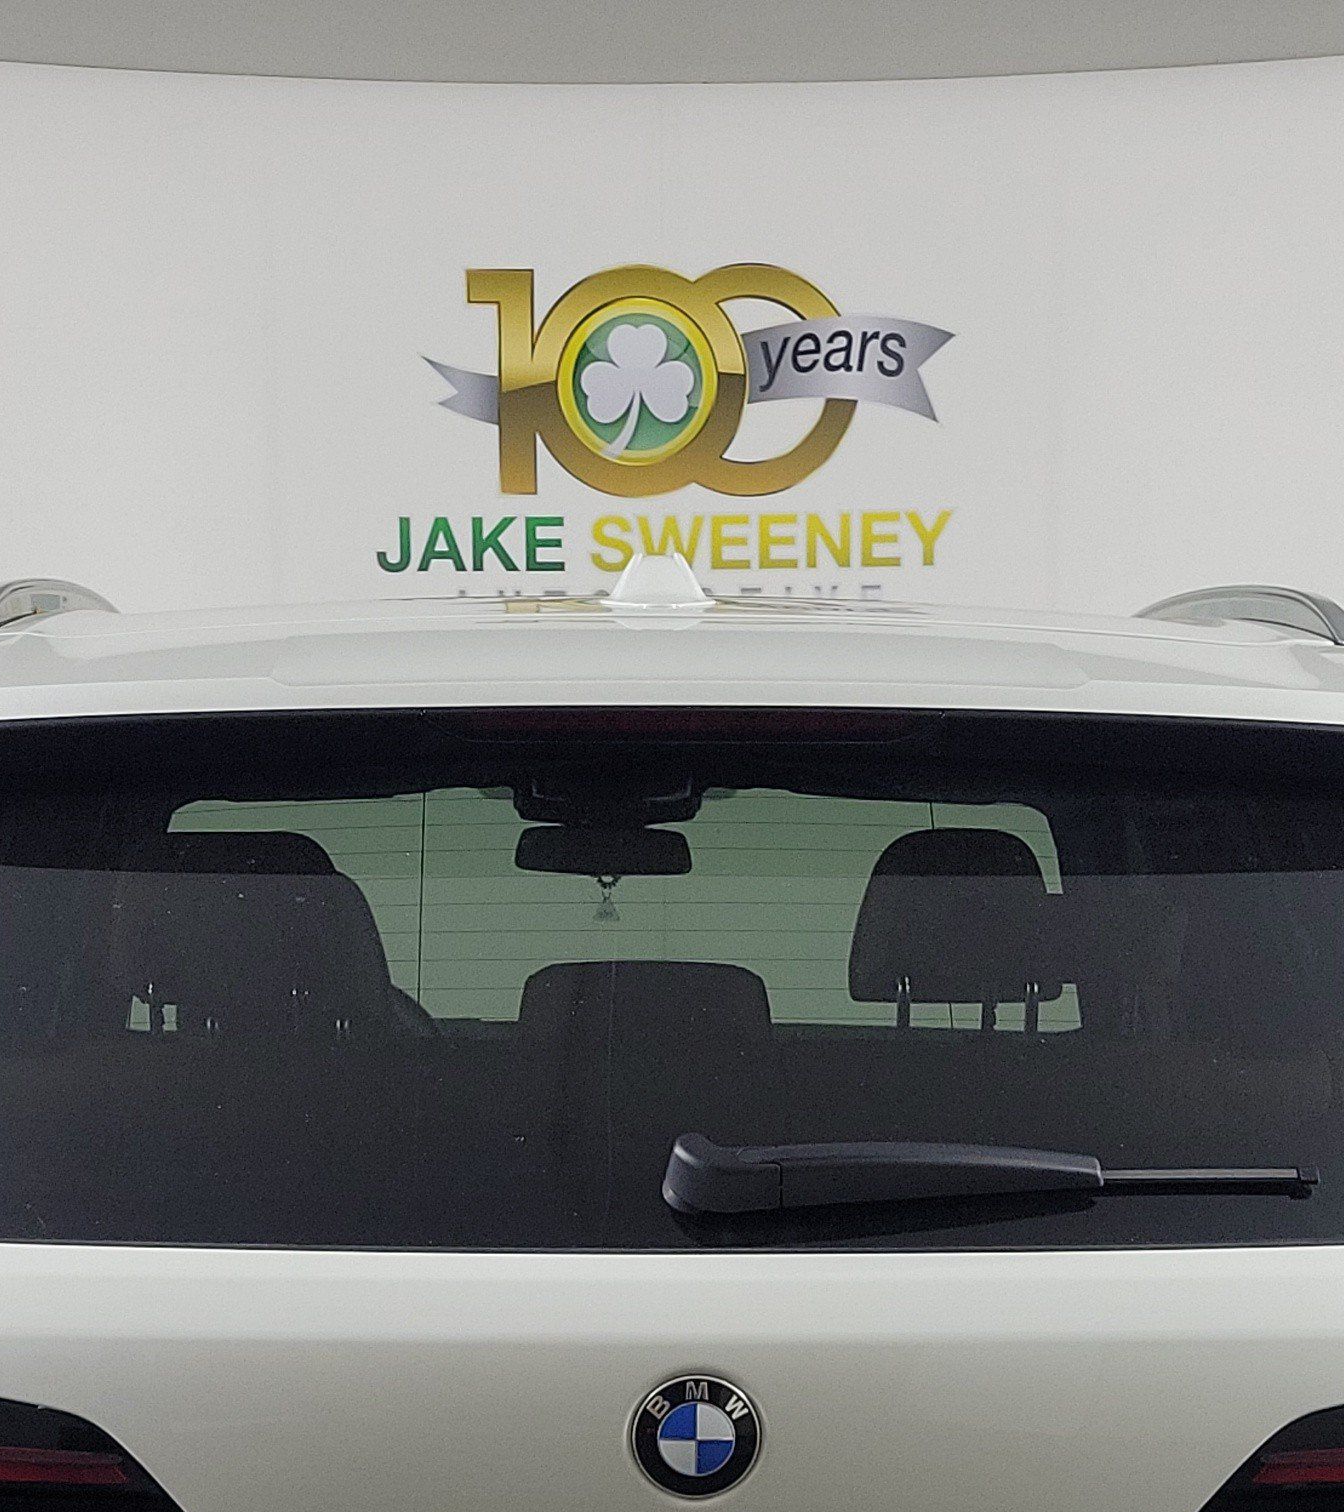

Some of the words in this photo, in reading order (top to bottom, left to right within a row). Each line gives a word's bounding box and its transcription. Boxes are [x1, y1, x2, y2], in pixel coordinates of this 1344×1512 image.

[465, 262, 858, 497] 100
[759, 328, 908, 392] years
[376, 515, 566, 573] JAKE
[589, 510, 953, 573] SWEENEY
[646, 1381, 749, 1420] BMW
